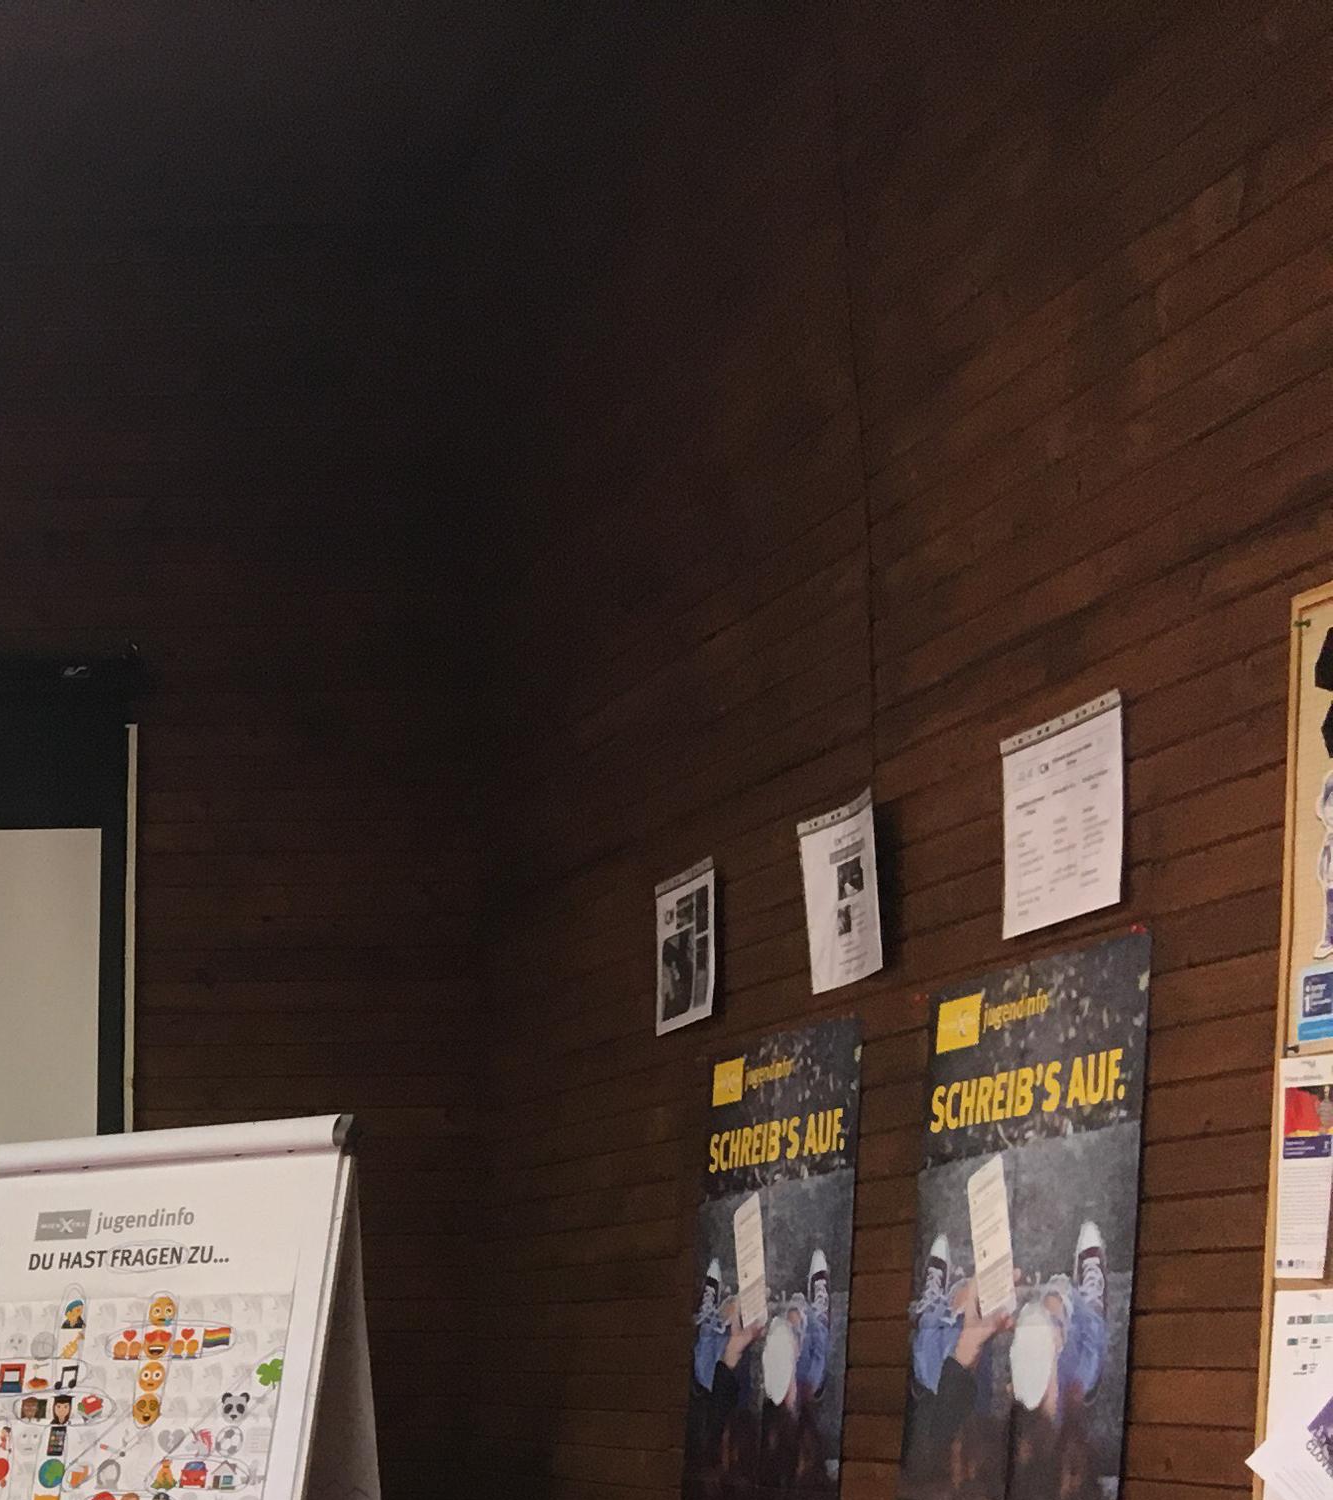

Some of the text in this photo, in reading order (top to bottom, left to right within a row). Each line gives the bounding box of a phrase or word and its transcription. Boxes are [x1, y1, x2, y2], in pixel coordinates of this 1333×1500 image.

[1065, 1048, 1126, 1110] AUF.
[802, 1107, 846, 1157] AUF.
[95, 1206, 195, 1236] jugendinfo
[28, 1245, 230, 1271] DU HAST FRAGEN ZU...
